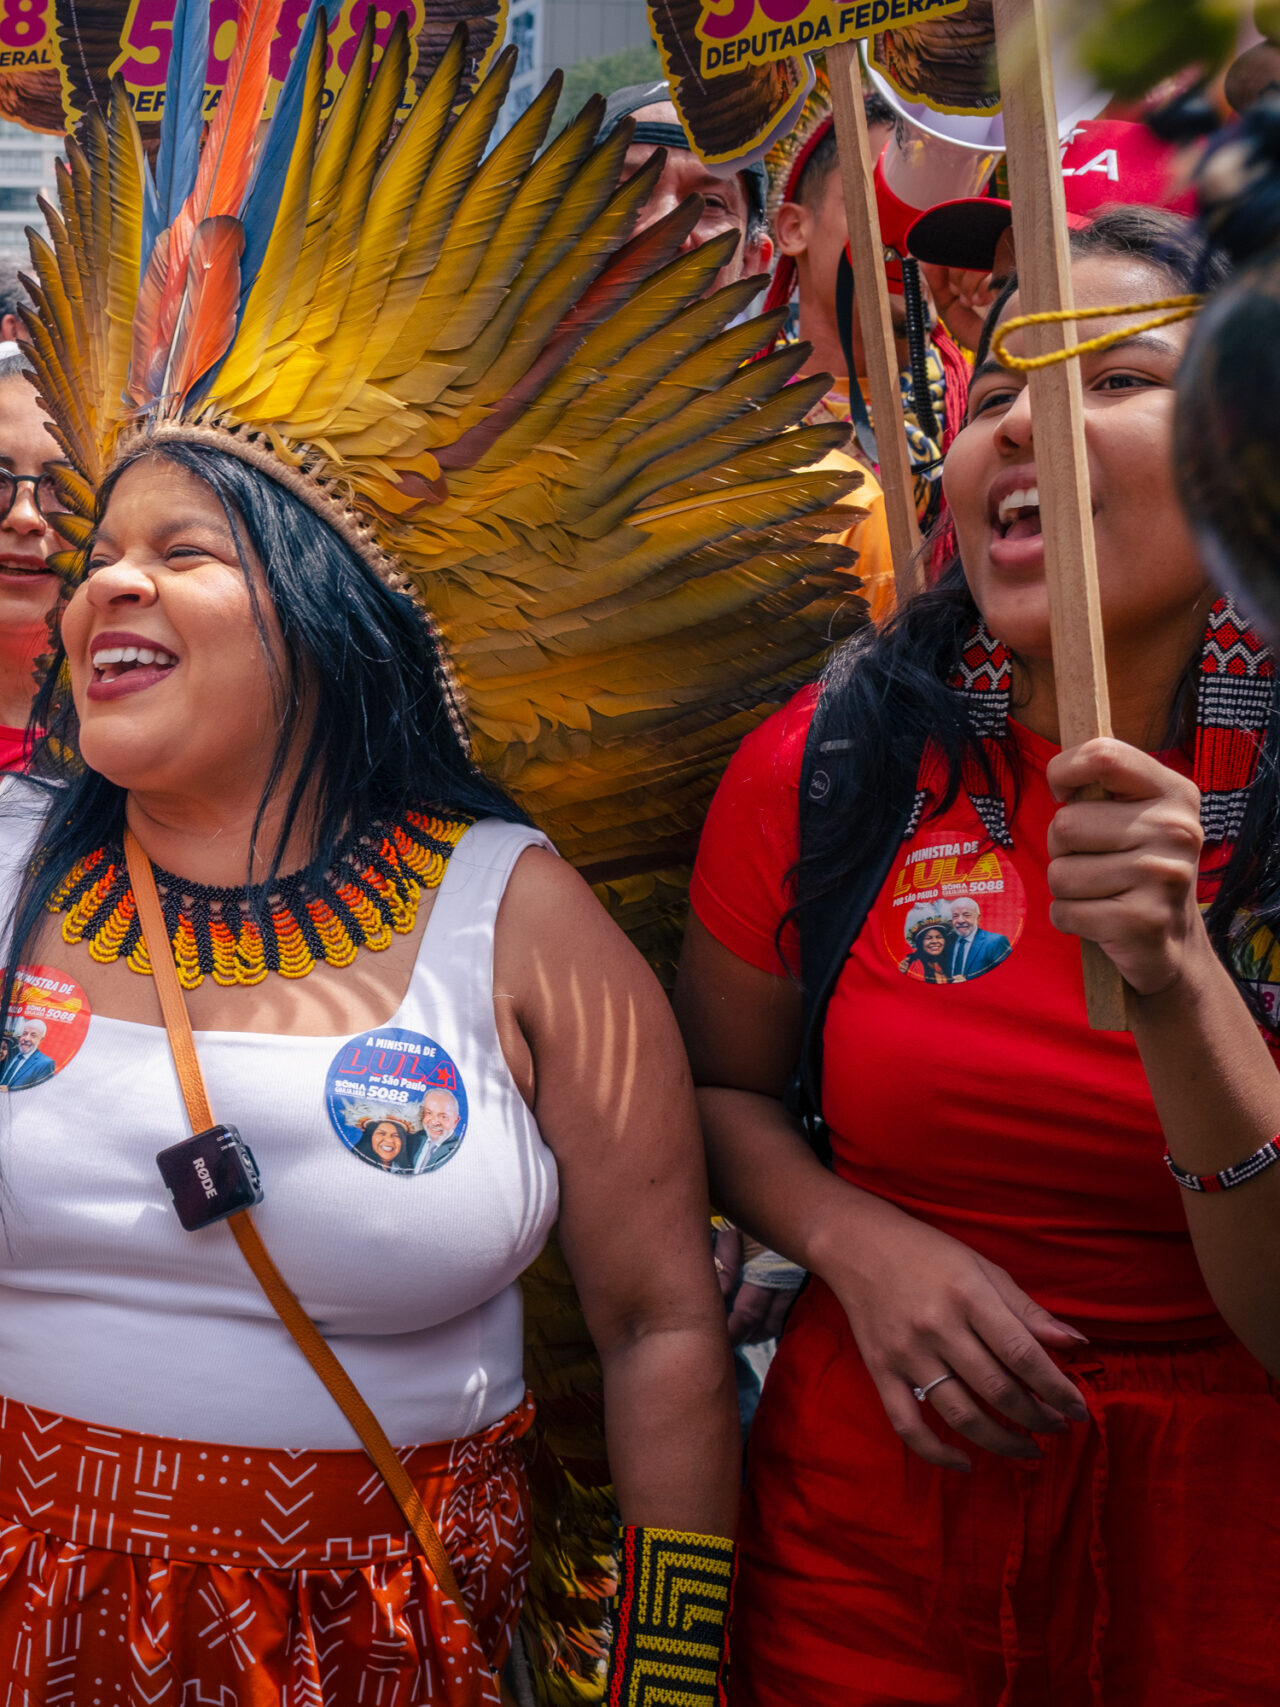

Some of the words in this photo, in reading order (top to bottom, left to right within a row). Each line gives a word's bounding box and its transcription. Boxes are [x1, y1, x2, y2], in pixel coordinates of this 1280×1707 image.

[706, 15, 831, 70] DEPUTADA
[839, 0, 960, 34] FEDER
[905, 854, 911, 867] A
[911, 843, 960, 863] MINISTRA
[963, 841, 979, 854] DE
[893, 852, 1003, 897] LULA
[969, 880, 1004, 892] 5088
[904, 892, 916, 904] SÃO
[917, 889, 939, 900] PAULO
[58, 983, 75, 994] DE
[45, 1008, 76, 1021] 5088
[366, 1037, 373, 1046] A
[375, 1038, 421, 1055] MINISTRA
[422, 1046, 437, 1058] DE
[339, 1047, 457, 1091] LULA
[381, 1074, 399, 1087] São
[400, 1077, 427, 1092] Paulo
[366, 1085, 410, 1103] 5088
[192, 1157, 219, 1199] RØDE
